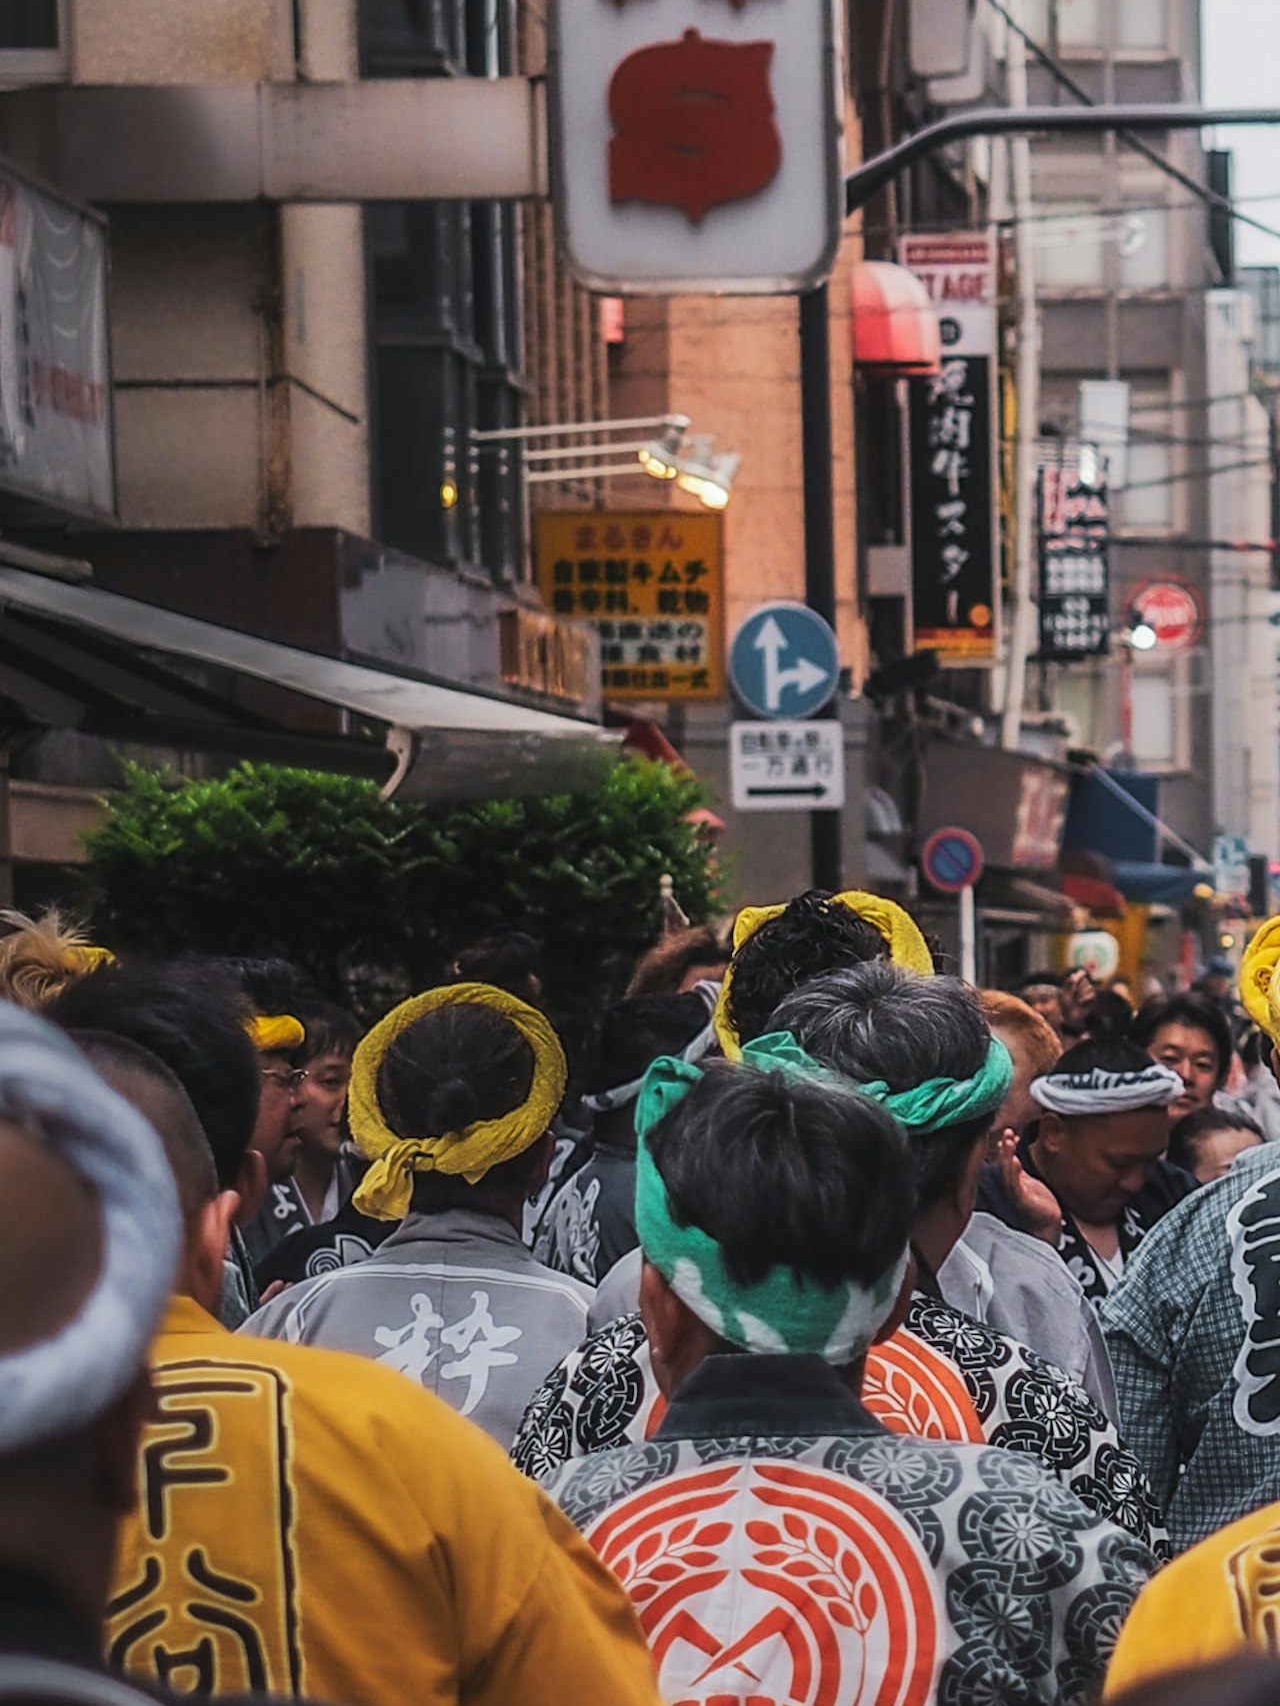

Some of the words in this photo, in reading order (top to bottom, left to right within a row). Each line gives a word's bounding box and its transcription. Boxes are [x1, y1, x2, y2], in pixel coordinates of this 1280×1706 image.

[574, 523, 684, 551] まるきん
[553, 559, 709, 584] 自家製キムチ
[741, 755, 833, 778] 一方通行
